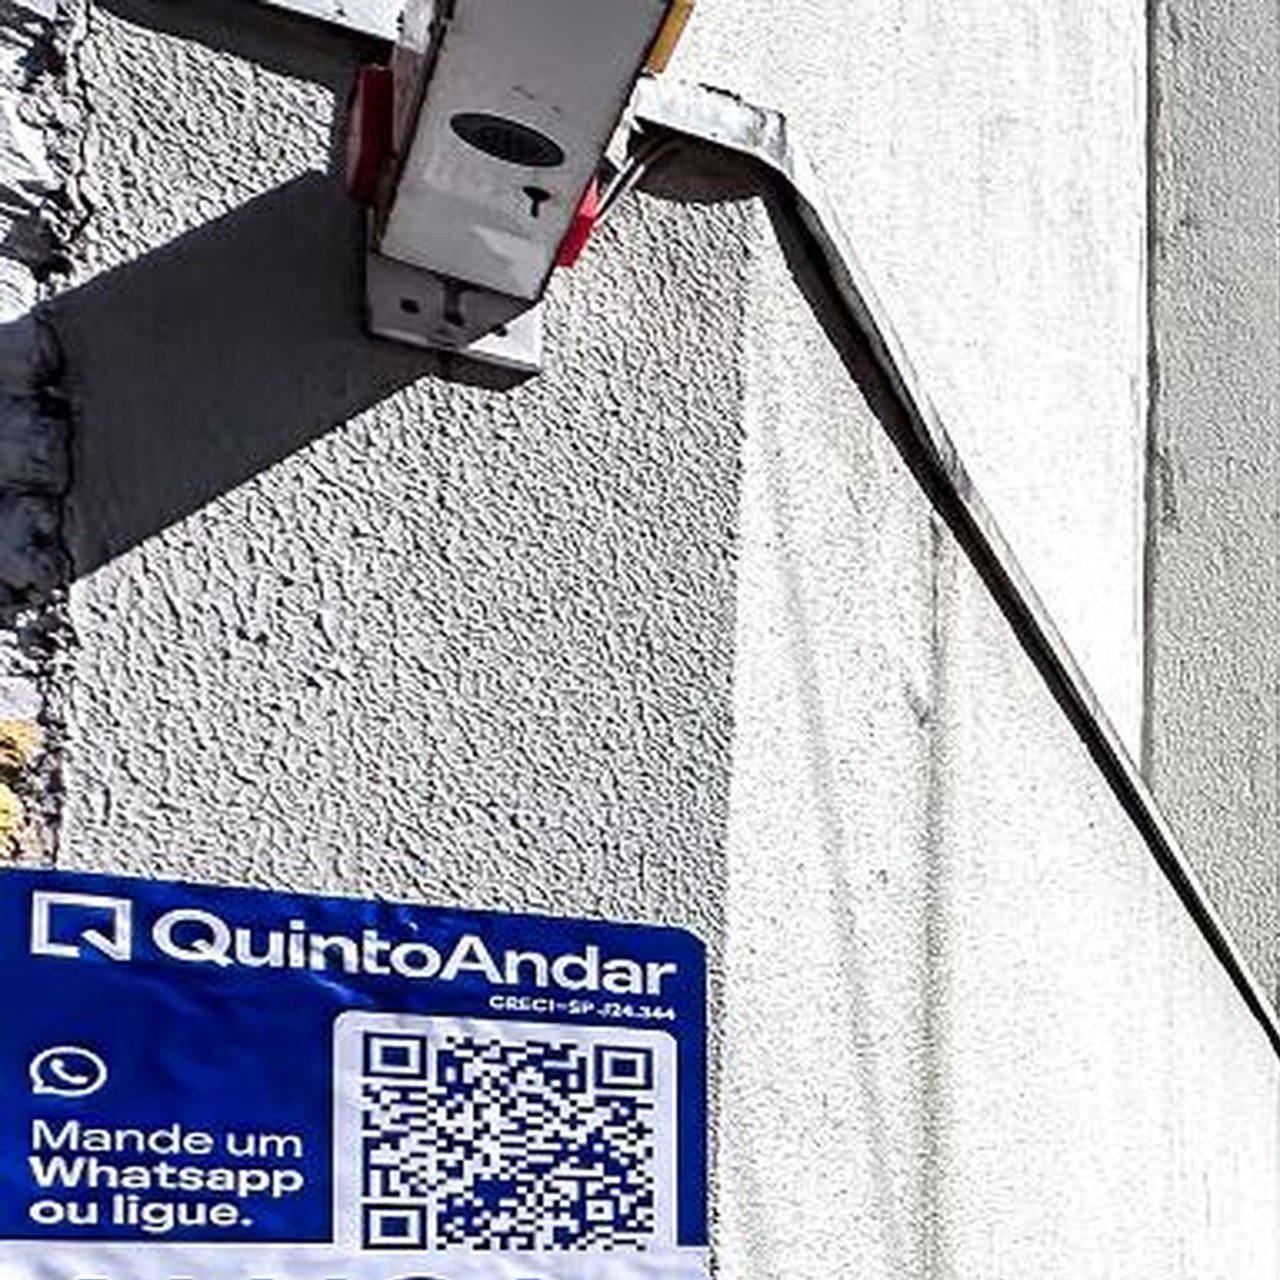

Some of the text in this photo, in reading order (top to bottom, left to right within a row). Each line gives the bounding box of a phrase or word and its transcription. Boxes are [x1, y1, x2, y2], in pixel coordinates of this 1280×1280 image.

[151, 908, 677, 996] QuintoAndar
[31, 1119, 304, 1158] Mande um
[28, 1155, 305, 1199] Whatsapp
[29, 1193, 254, 1234] ou ligue.
